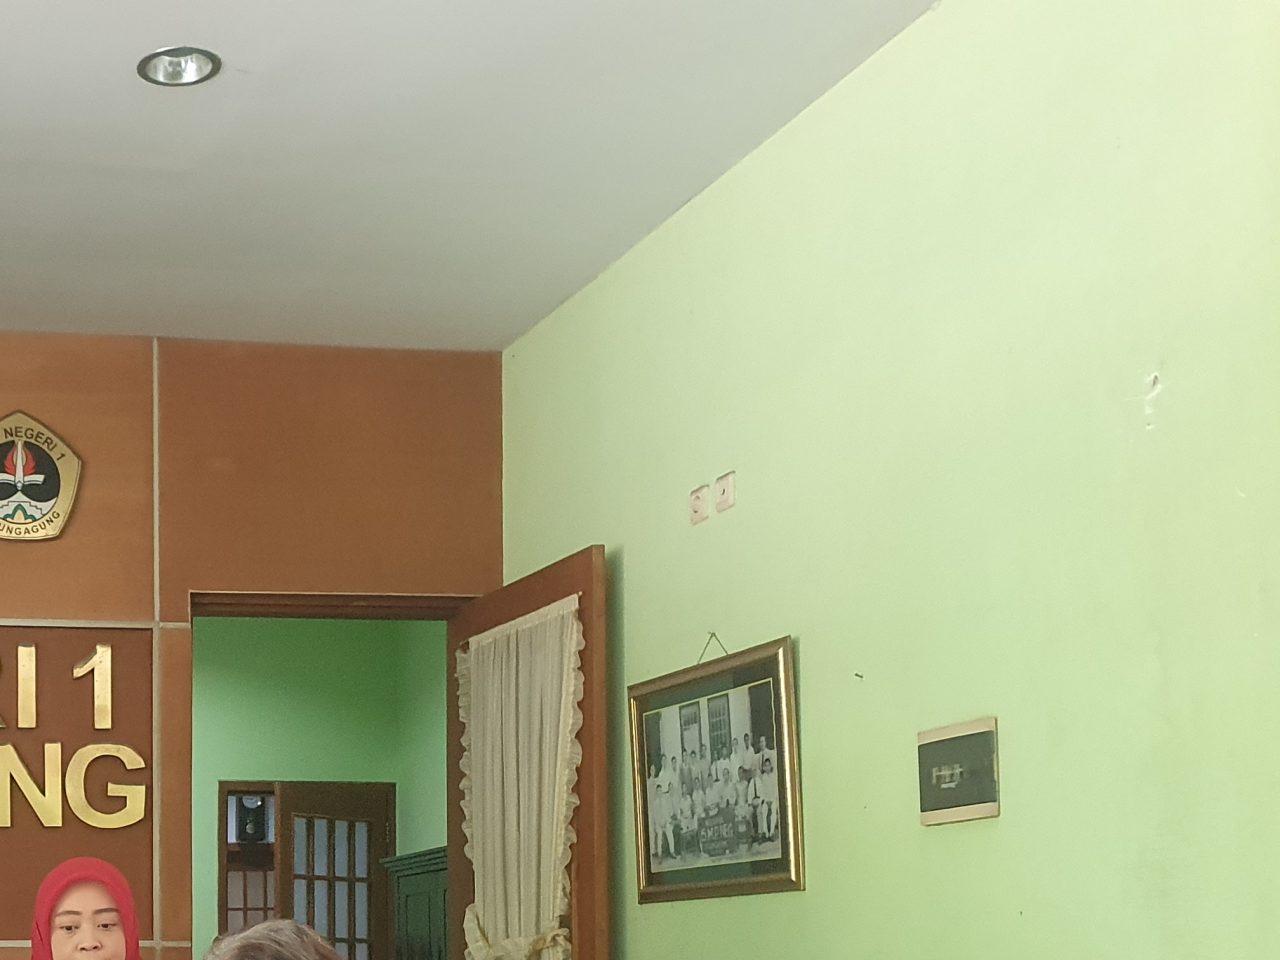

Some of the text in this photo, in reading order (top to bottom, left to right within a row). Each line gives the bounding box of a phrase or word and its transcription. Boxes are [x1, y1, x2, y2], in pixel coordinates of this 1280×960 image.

[3, 426, 57, 453] NEGERI
[56, 453, 66, 461] 1
[73, 643, 113, 730] 1
